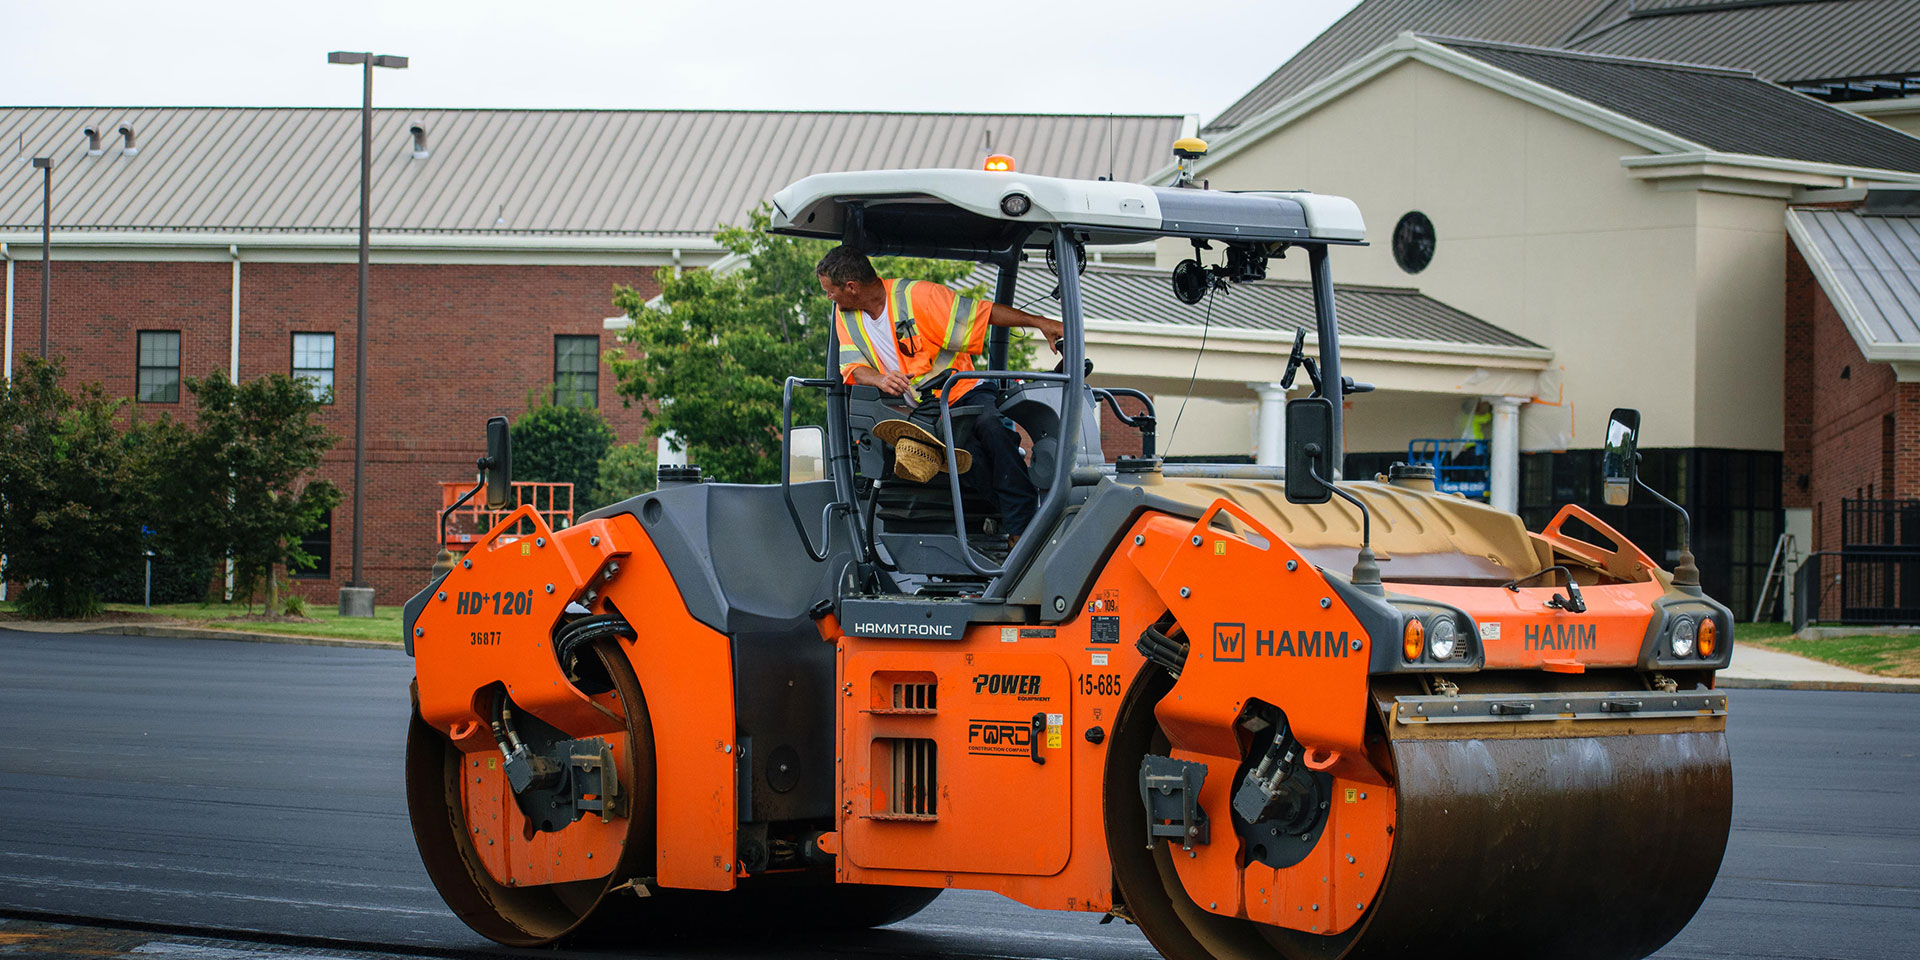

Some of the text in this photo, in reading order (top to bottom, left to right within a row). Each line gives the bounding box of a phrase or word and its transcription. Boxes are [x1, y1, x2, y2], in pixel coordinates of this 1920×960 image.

[1104, 600, 1115, 612] 109
[470, 632, 502, 646] 36877
[854, 622, 952, 636] HAMMTRONIC
[1524, 624, 1596, 651] HAMM
[1256, 630, 1348, 658] HAMM
[972, 673, 1042, 696] POWER
[1078, 673, 1121, 696] 15-685
[969, 724, 1031, 746] FORD
